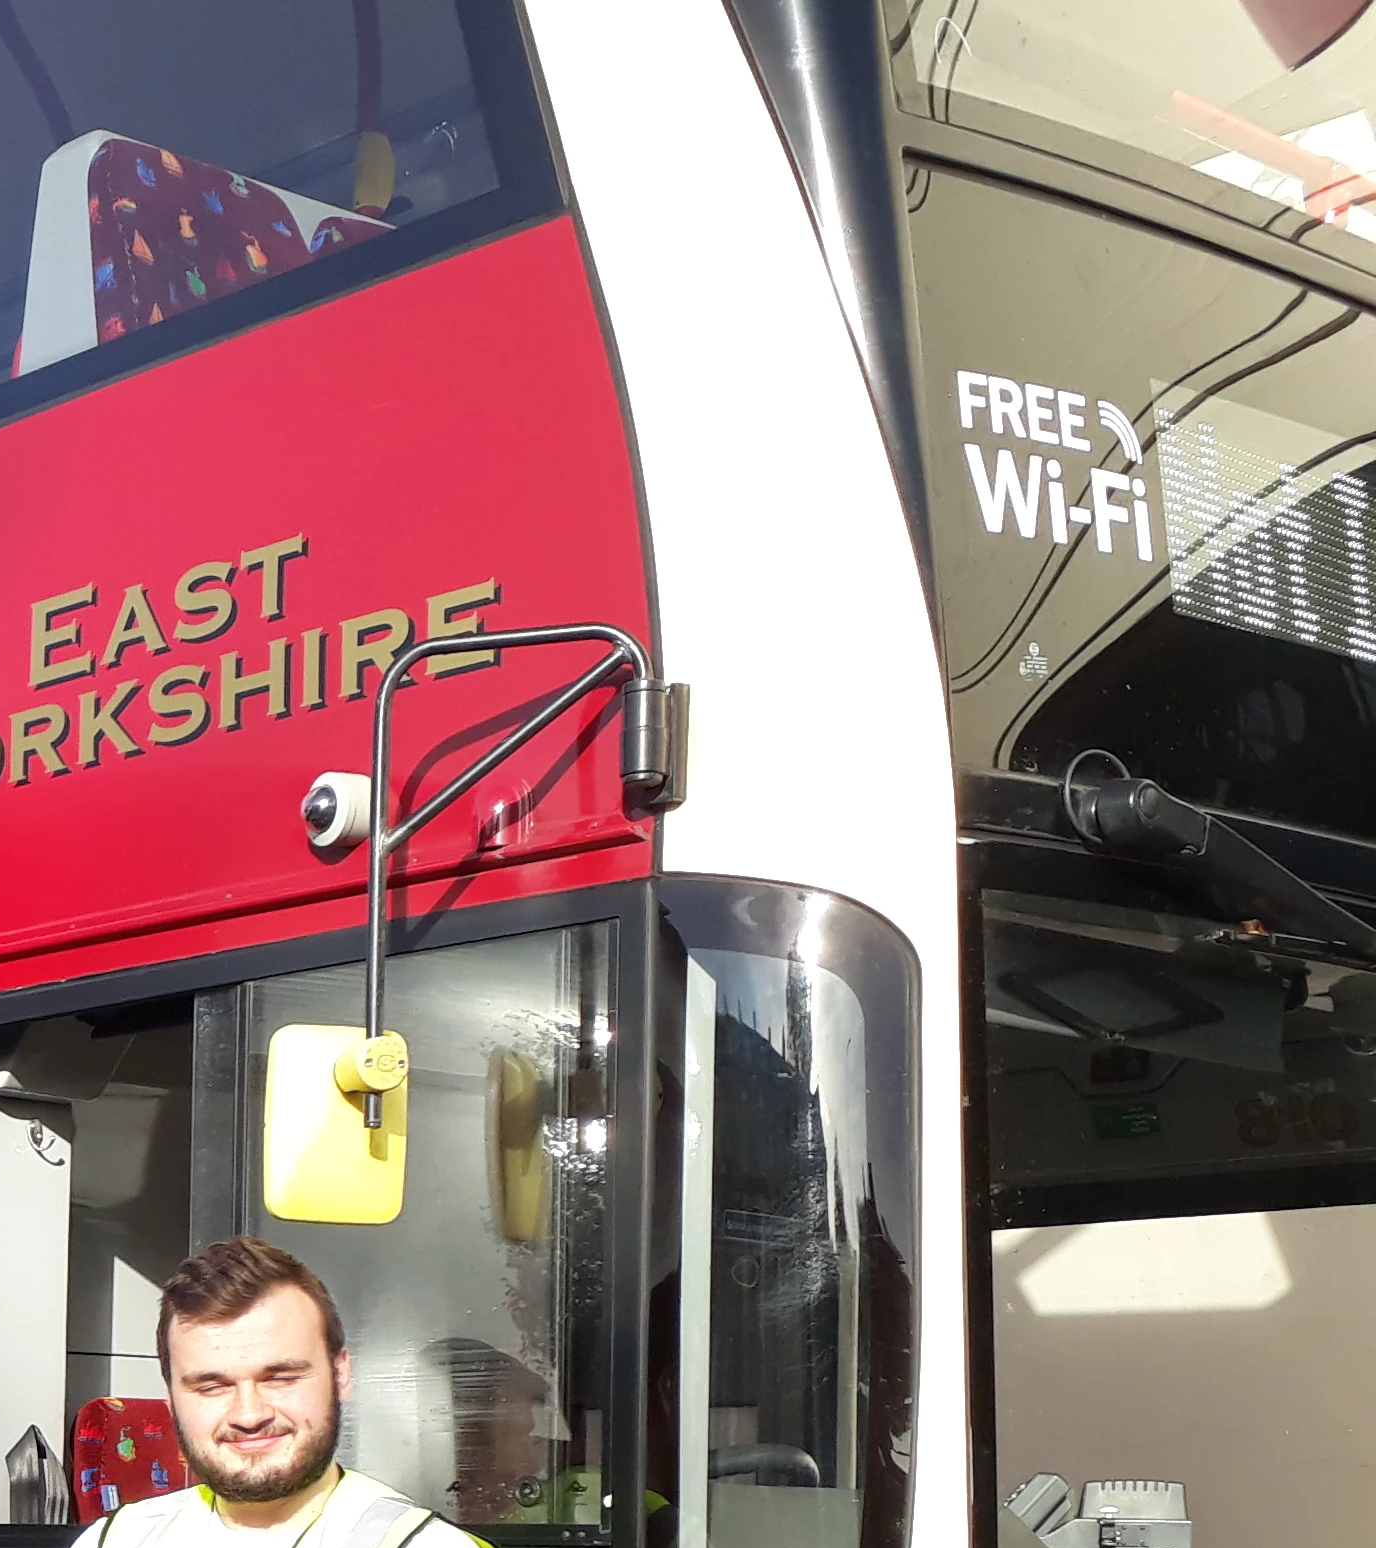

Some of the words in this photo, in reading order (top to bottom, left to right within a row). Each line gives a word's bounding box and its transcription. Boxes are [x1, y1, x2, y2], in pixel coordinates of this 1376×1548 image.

[955, 369, 1093, 453] FREE
[962, 442, 1155, 563] Wi-Fi
[29, 532, 308, 690] EAST
